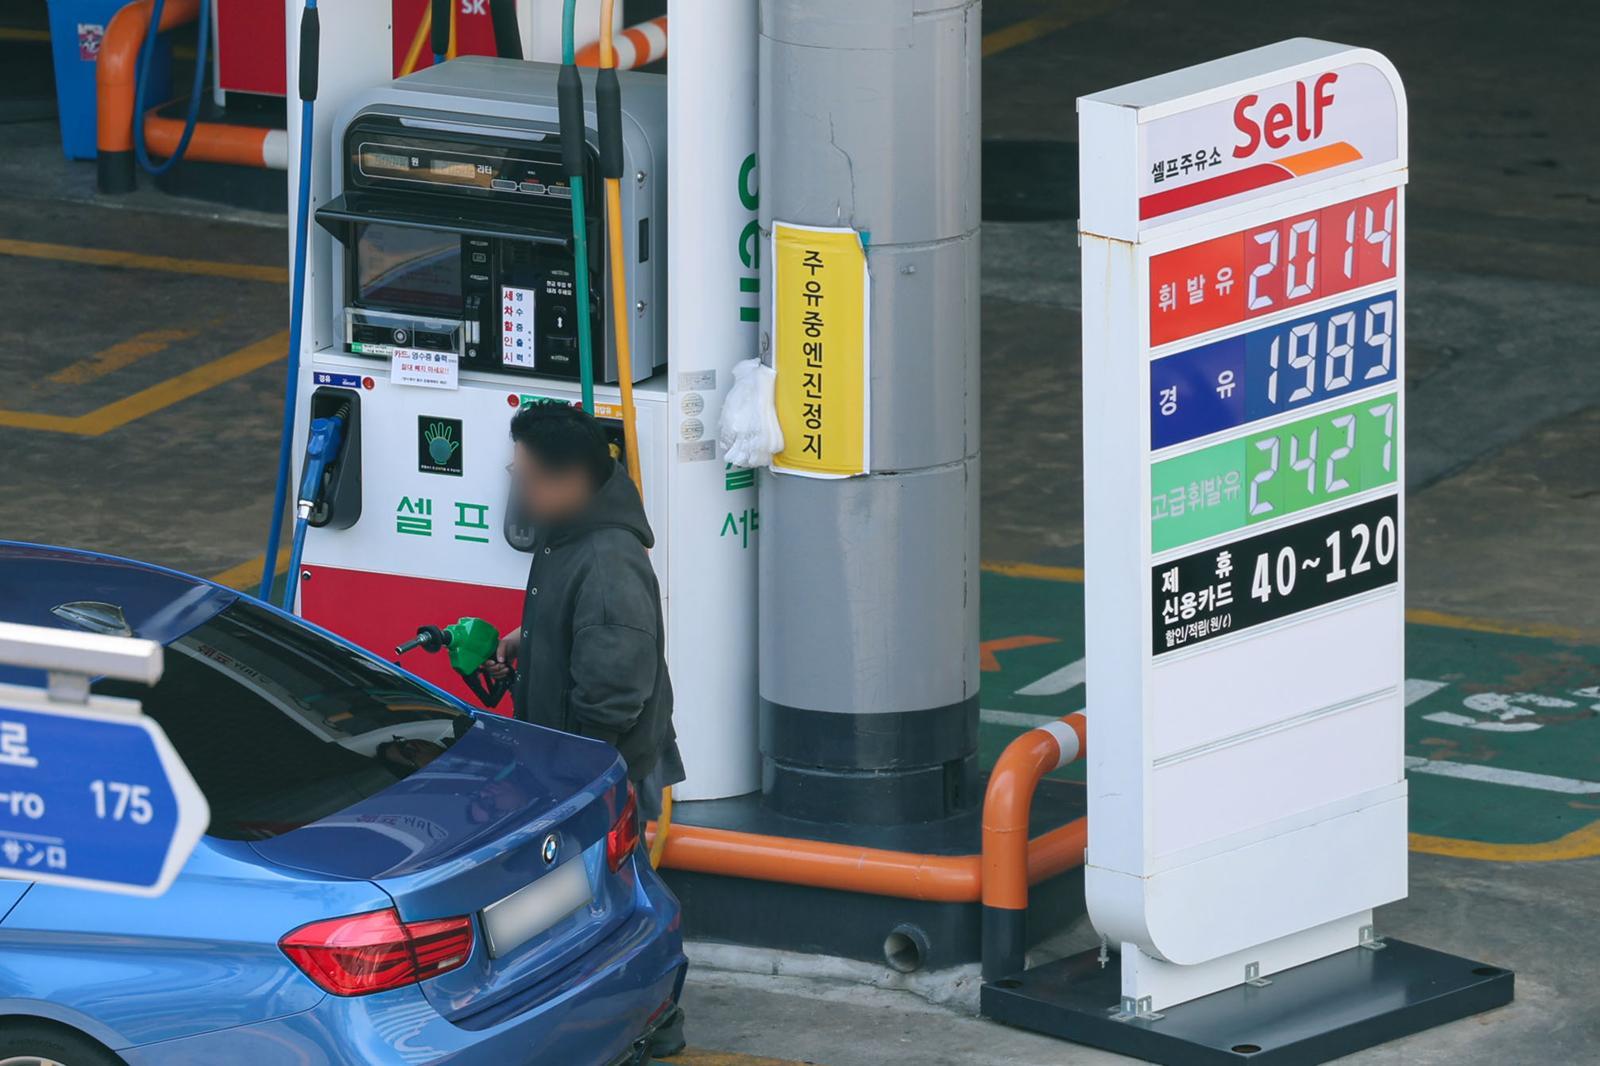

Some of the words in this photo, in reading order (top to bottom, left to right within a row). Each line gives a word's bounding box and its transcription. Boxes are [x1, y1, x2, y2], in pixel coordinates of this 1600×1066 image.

[1232, 72, 1338, 159] Self
[1151, 147, 1222, 183] 셀프주유소
[1248, 199, 1394, 311] 2014
[1158, 266, 1235, 313] 휘발유
[1268, 300, 1393, 404] 1989
[1249, 402, 1393, 516] 2427
[1151, 471, 1241, 520] 고급휘발유
[1162, 581, 1234, 625] 신용카드
[90, 780, 153, 825] 175
